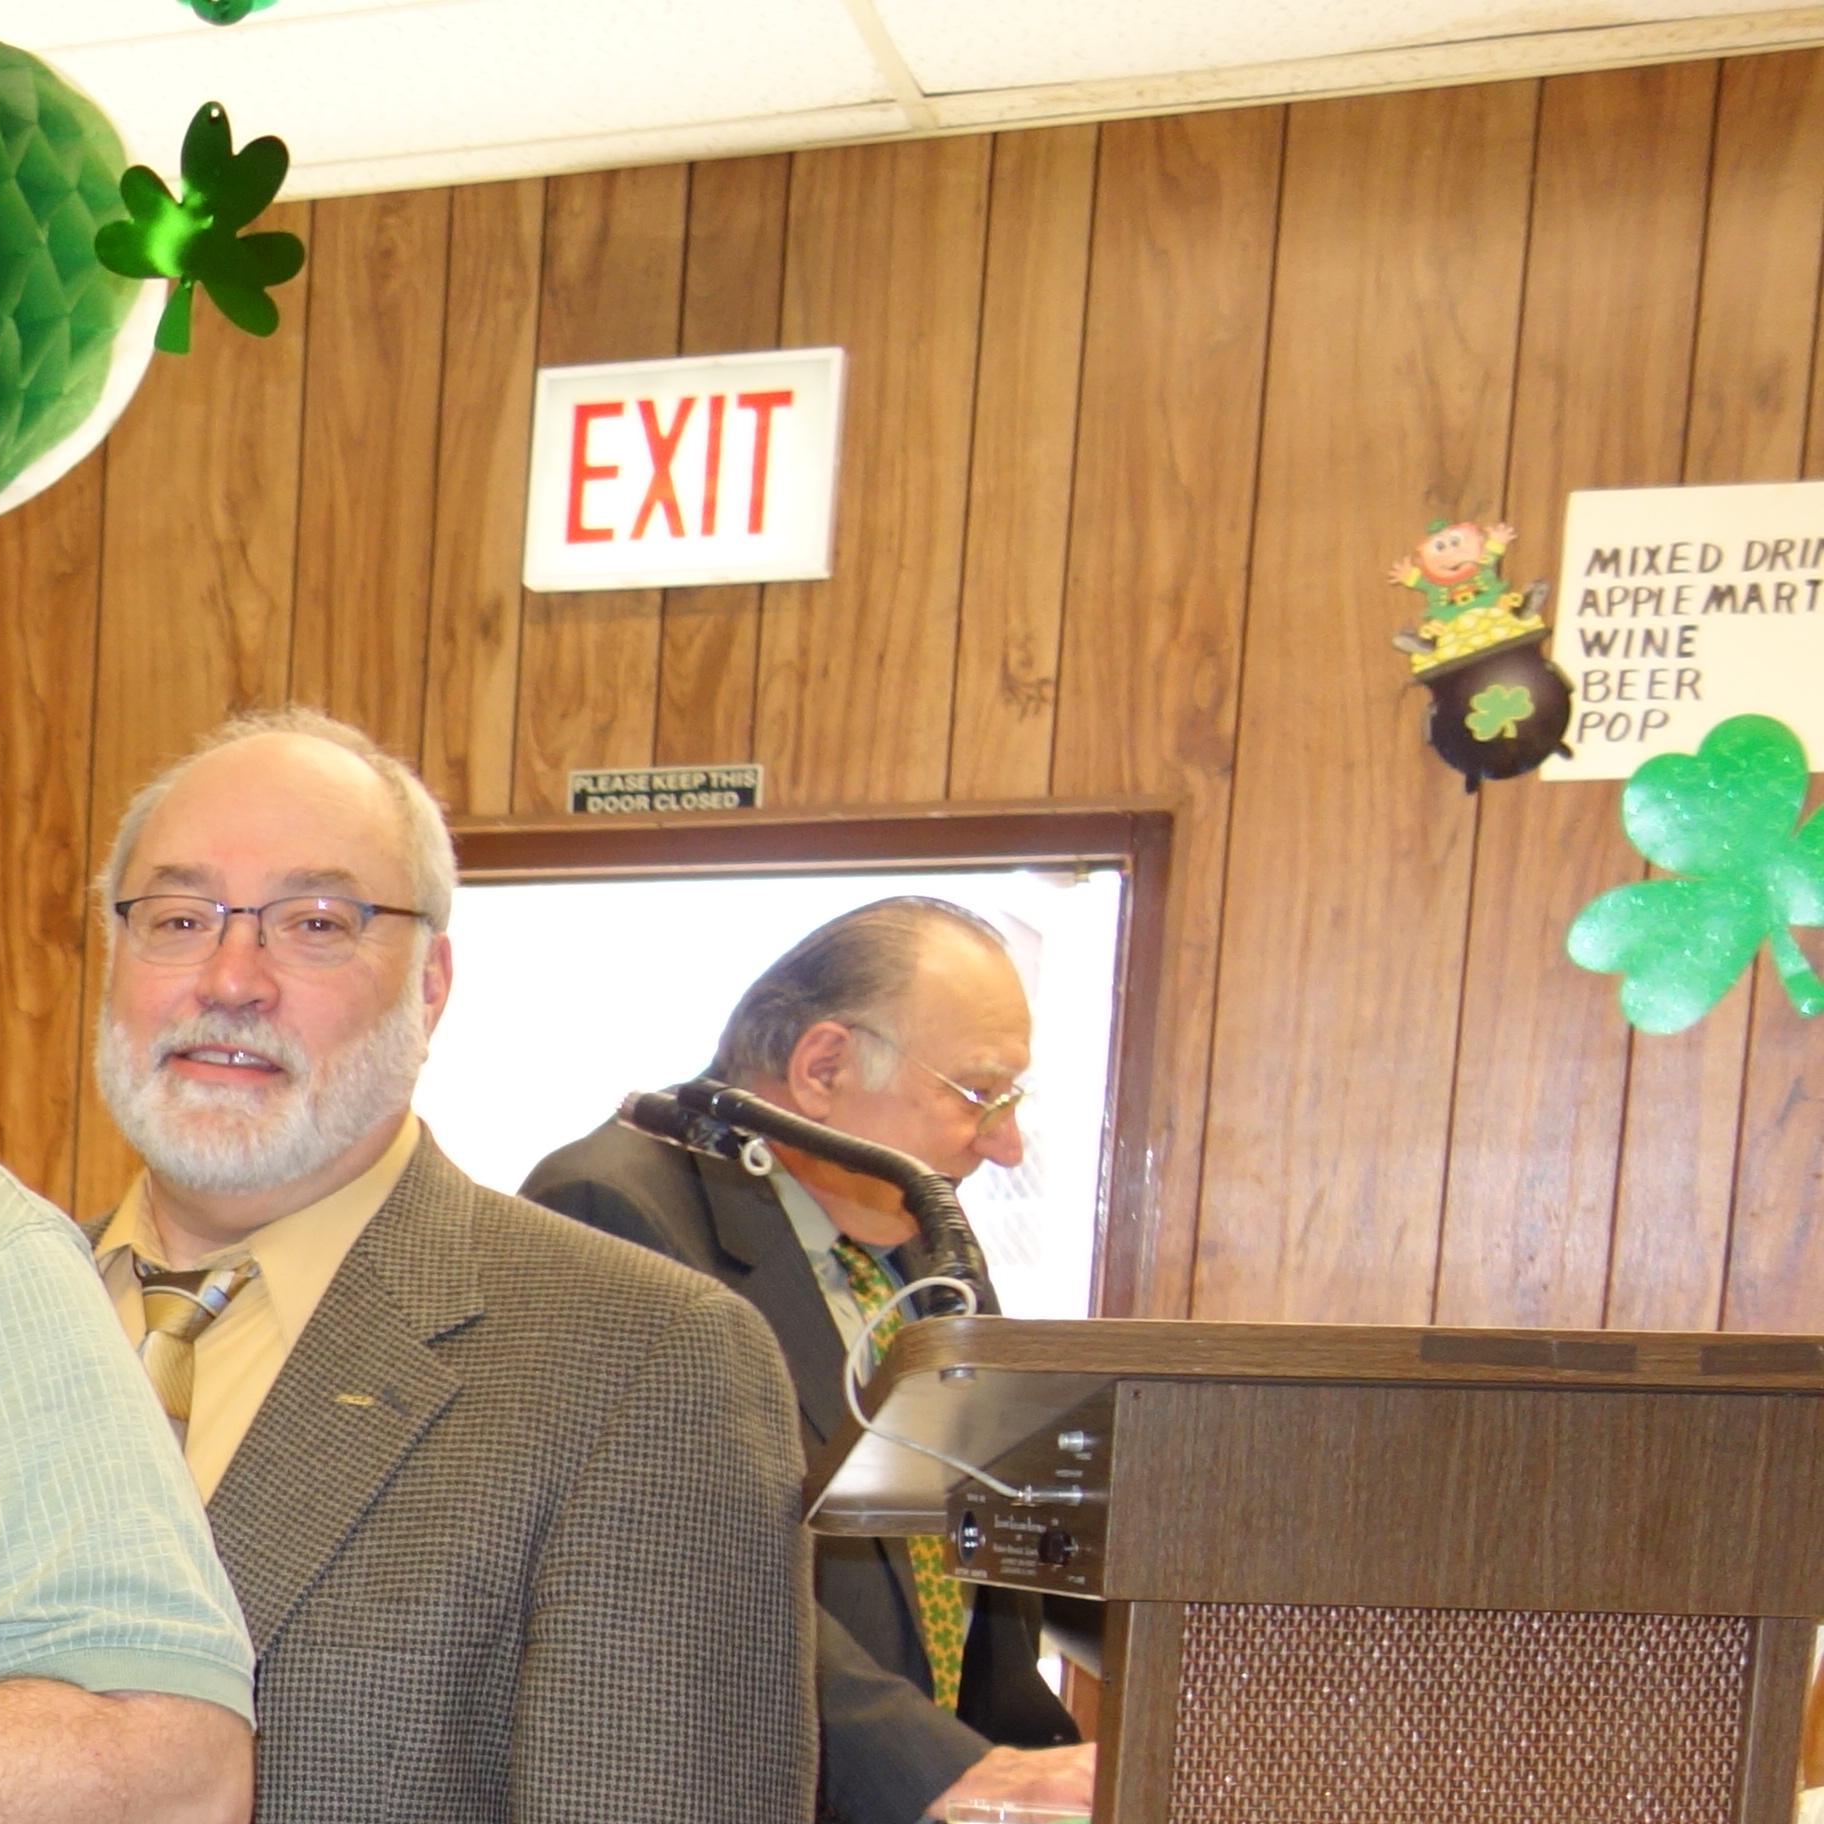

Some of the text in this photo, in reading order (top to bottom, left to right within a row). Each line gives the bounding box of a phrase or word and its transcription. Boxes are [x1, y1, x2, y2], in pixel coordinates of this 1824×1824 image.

[565, 389, 794, 544] EXIT
[1584, 541, 1723, 578] MIXED
[1577, 578, 1824, 618] APPLE MART
[1578, 624, 1699, 659] WINE
[1580, 667, 1702, 703] BEER
[1576, 708, 1670, 744] POP
[574, 769, 757, 793] PLEASE KEEP THIS
[586, 790, 741, 814] DOOR CLOSED
